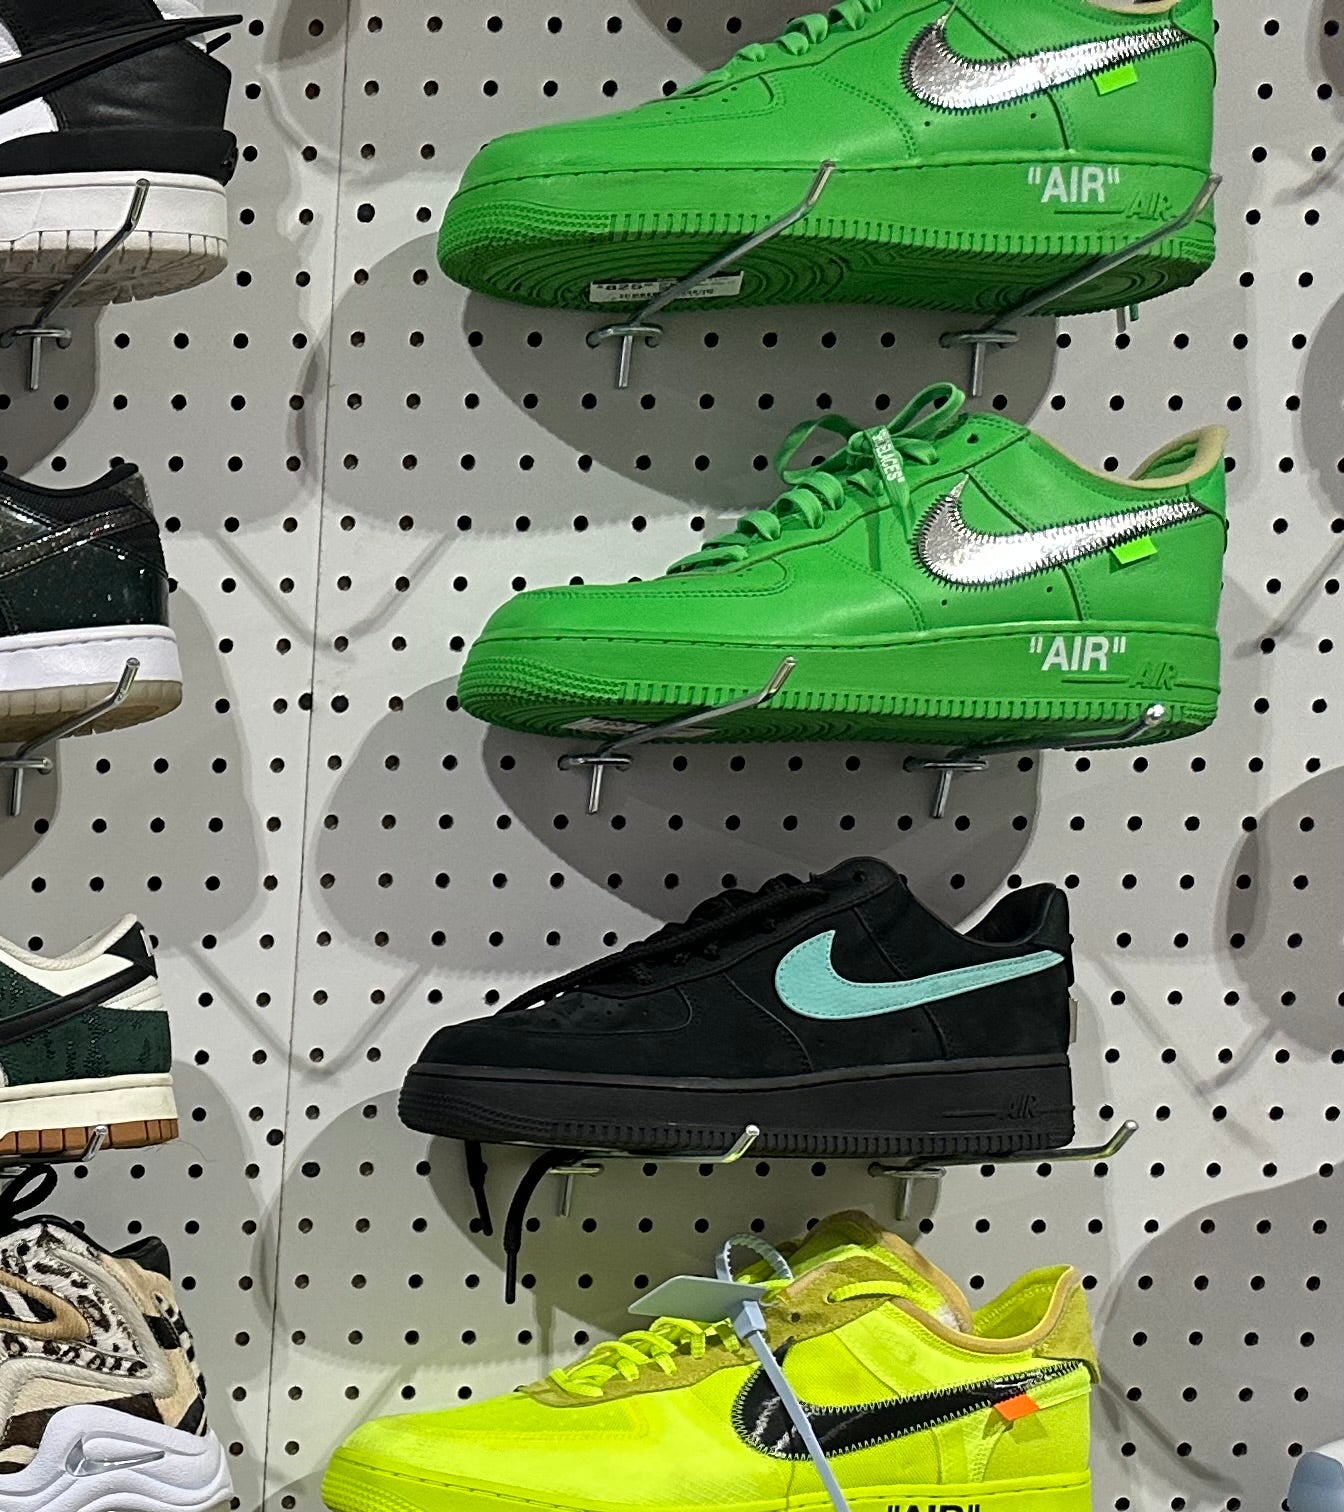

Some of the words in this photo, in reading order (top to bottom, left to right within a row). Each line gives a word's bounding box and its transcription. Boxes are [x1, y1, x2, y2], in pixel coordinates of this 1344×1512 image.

[1027, 166, 1120, 203] "AIR"
[1029, 636, 1126, 671] "AIR"
[1128, 662, 1177, 691] AIR
